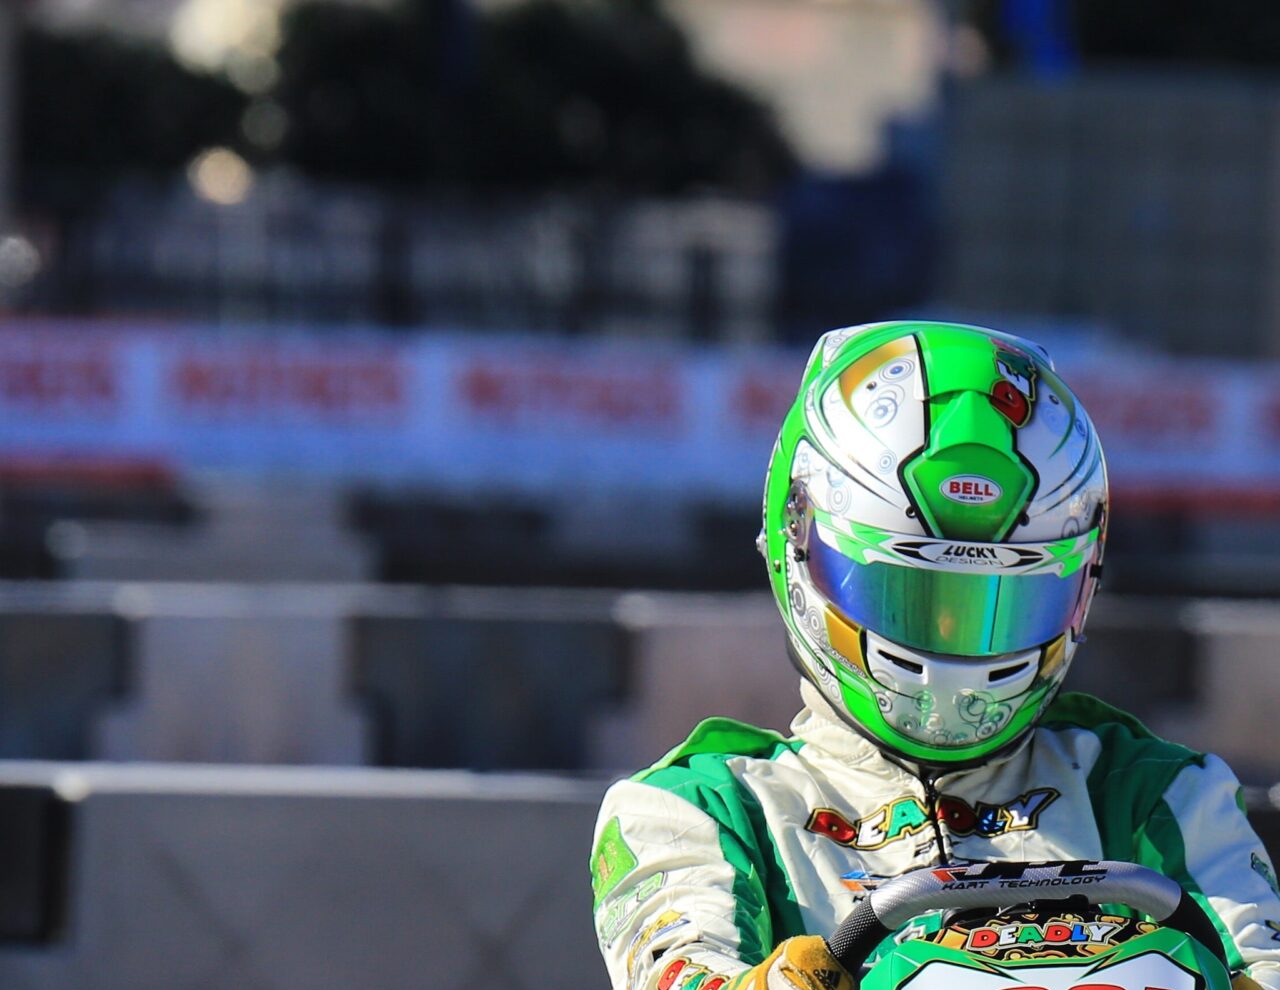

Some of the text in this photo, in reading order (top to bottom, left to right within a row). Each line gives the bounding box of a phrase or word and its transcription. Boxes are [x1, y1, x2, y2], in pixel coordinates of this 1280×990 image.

[949, 481, 995, 497] BELL
[942, 545, 998, 559] LUCKY
[935, 556, 1005, 566] DESIGN
[804, 788, 1061, 850] DEADLY
[942, 875, 1106, 892] KART TECHNOLOGY
[966, 922, 1122, 950] DEADLY
